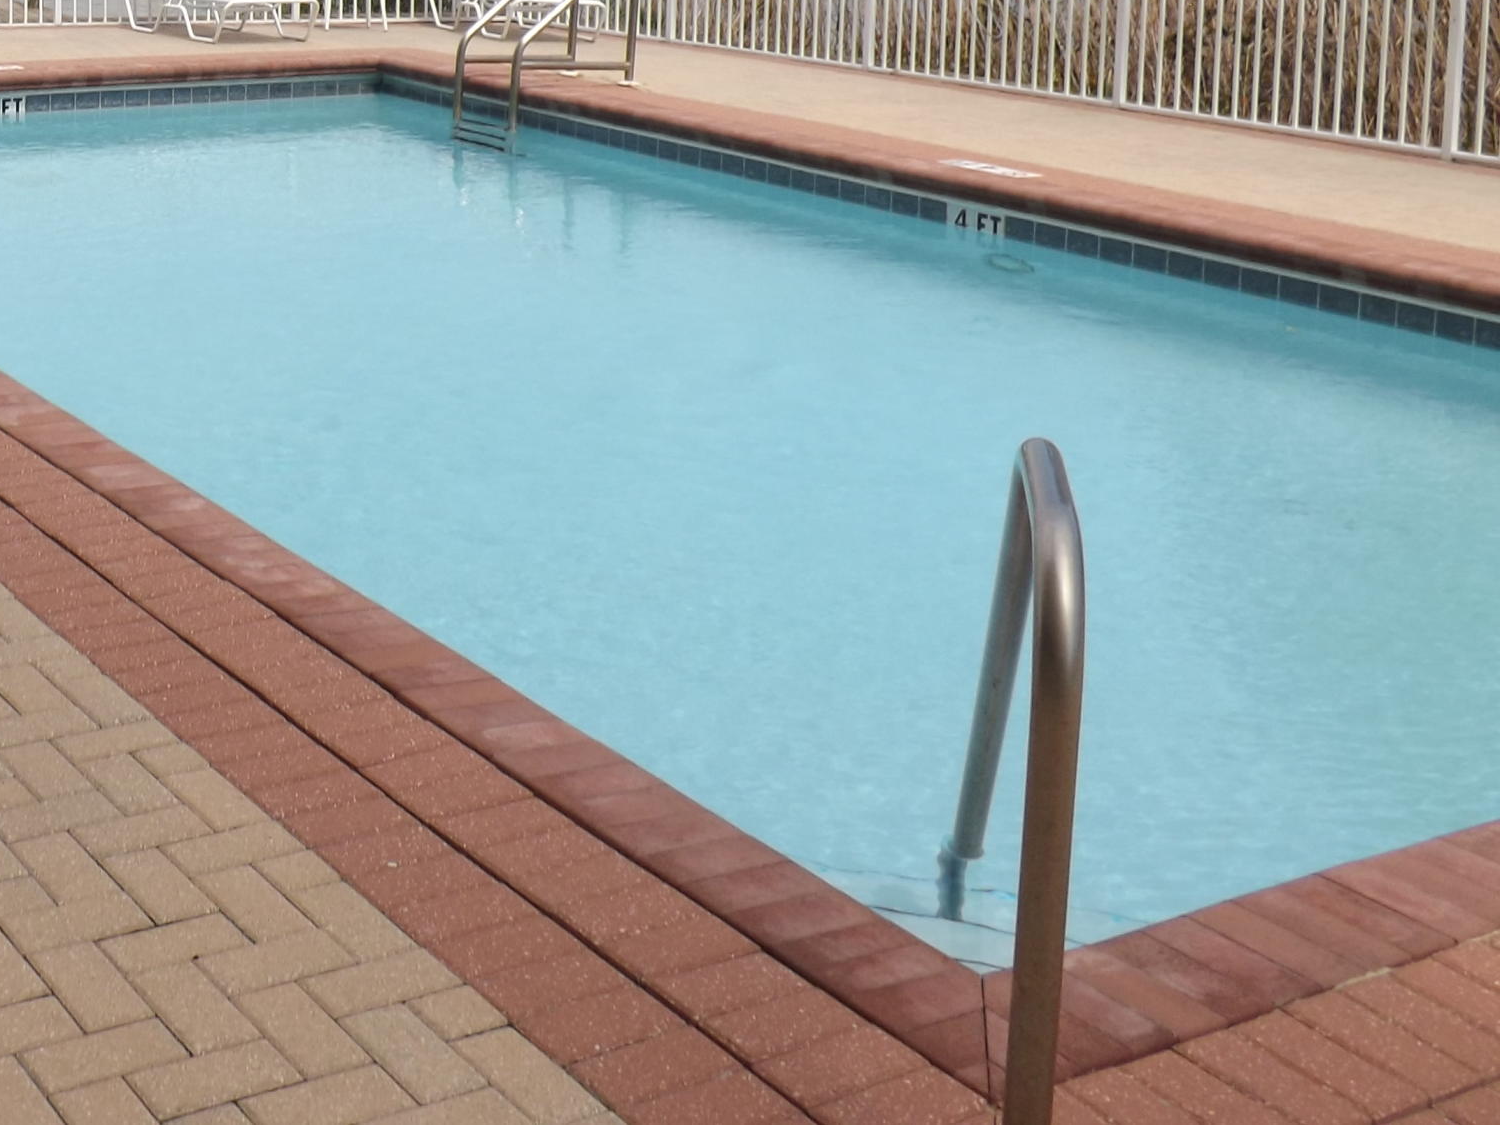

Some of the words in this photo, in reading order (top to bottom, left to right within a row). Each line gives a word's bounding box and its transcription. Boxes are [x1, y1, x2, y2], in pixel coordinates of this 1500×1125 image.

[2, 98, 23, 114] FT
[954, 209, 967, 228] 4
[977, 212, 1001, 235] FT
